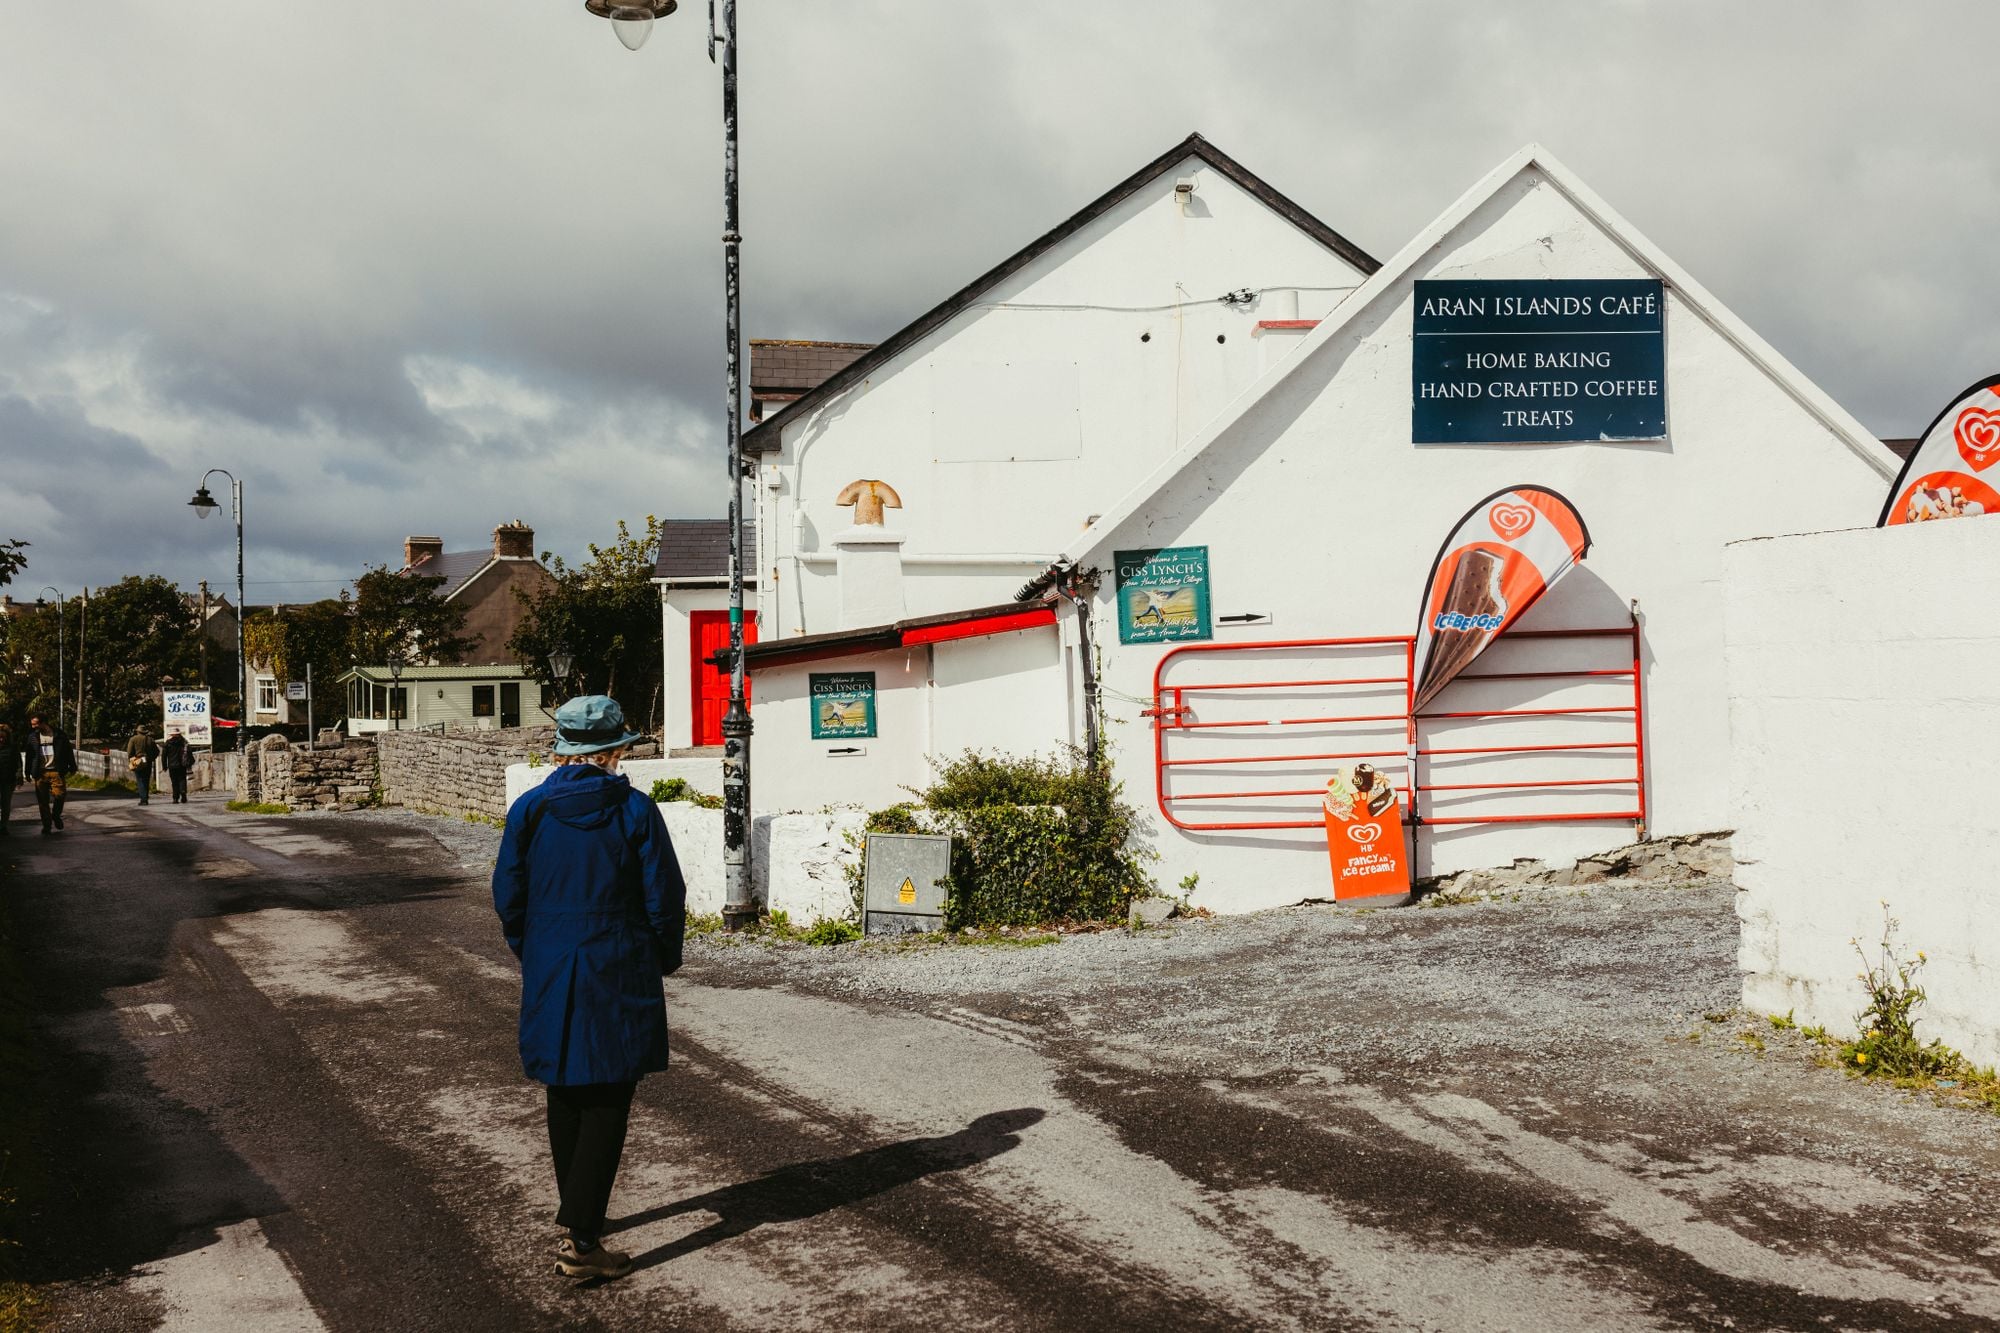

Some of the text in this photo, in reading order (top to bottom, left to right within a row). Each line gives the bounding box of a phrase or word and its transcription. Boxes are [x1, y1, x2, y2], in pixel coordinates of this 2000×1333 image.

[1421, 293, 1656, 316] ARAN ISLANDS CAFÉ
[1466, 351, 1611, 369] HOME BAKING
[1420, 380, 1658, 398] HAND CRAFTED COFFEE
[1503, 410, 1574, 427] TREATS
[1144, 556, 1170, 564] Welcome
[1152, 562, 1203, 576] LYNCH'S
[1434, 611, 1504, 631] ICEBERGER
[168, 693, 206, 702] SEACREST
[168, 702, 205, 712] B & B
